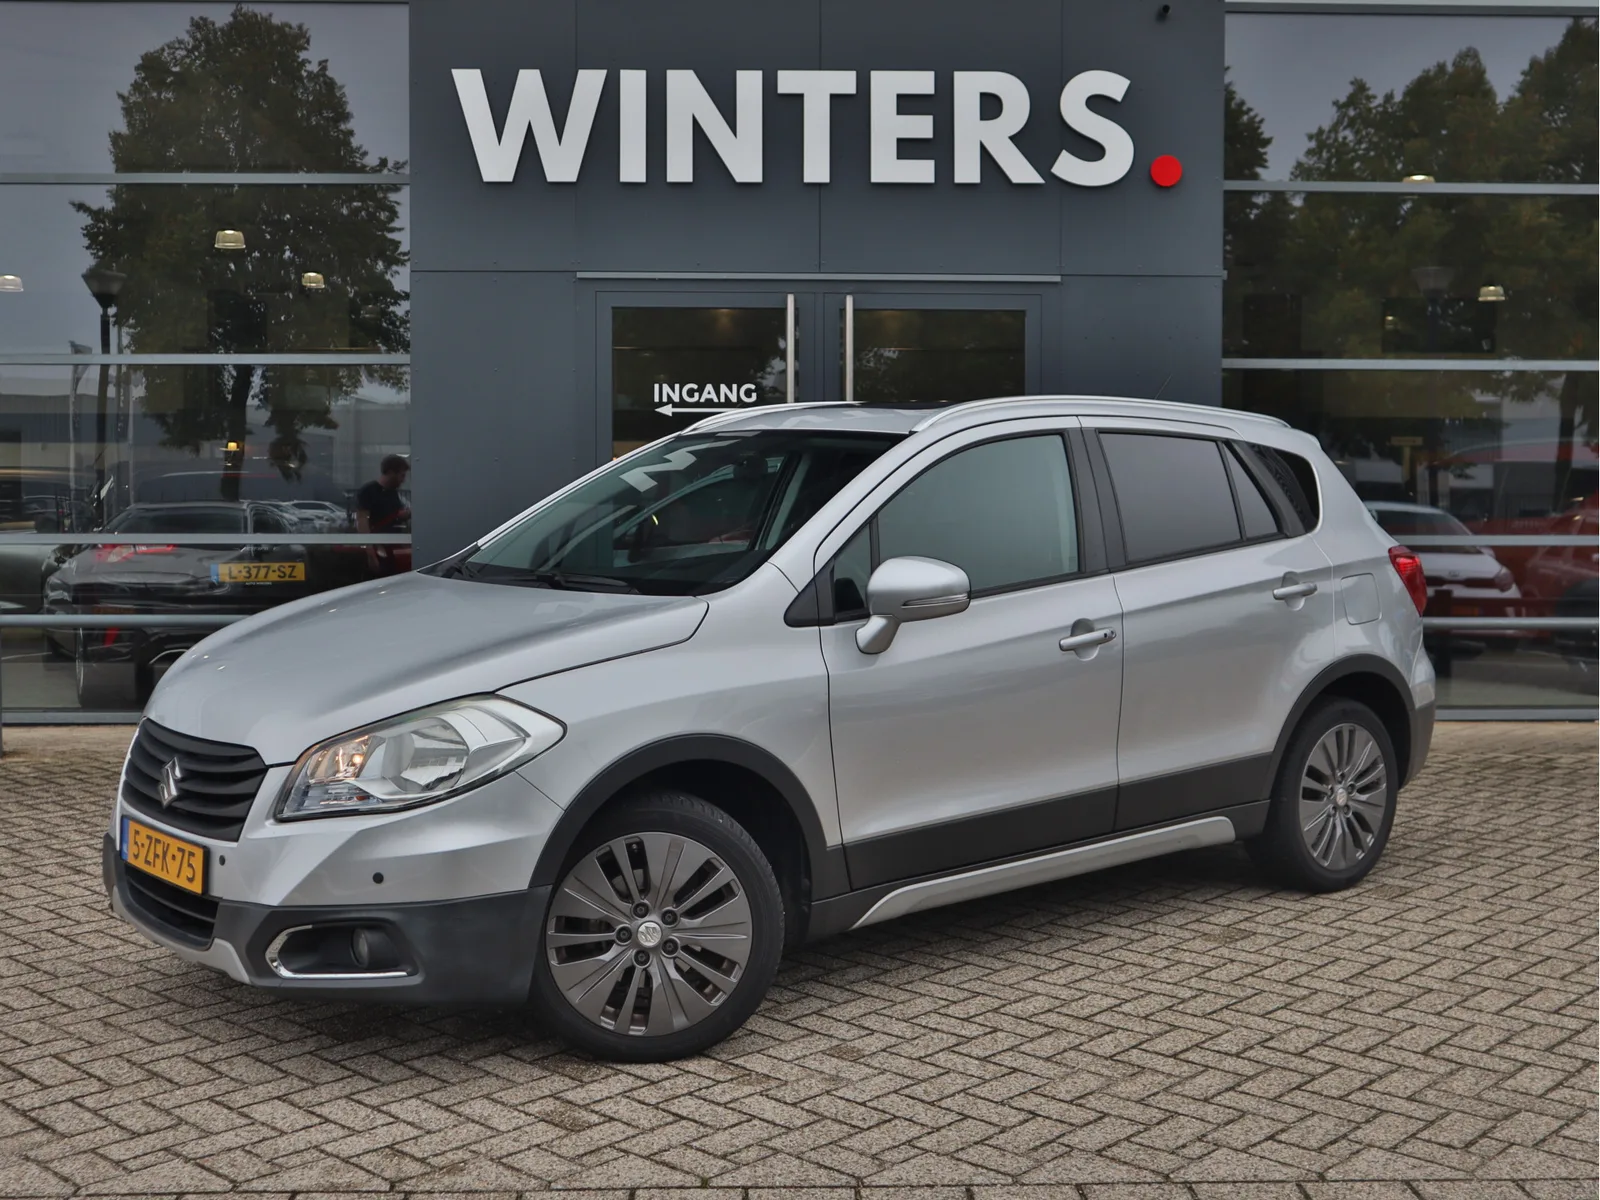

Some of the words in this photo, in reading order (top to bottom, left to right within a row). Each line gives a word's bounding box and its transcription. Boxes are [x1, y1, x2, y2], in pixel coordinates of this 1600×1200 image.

[653, 383, 757, 403] INGANG
[228, 565, 296, 579] L-377-SZ
[133, 829, 196, 883] 5-ZFK-75
